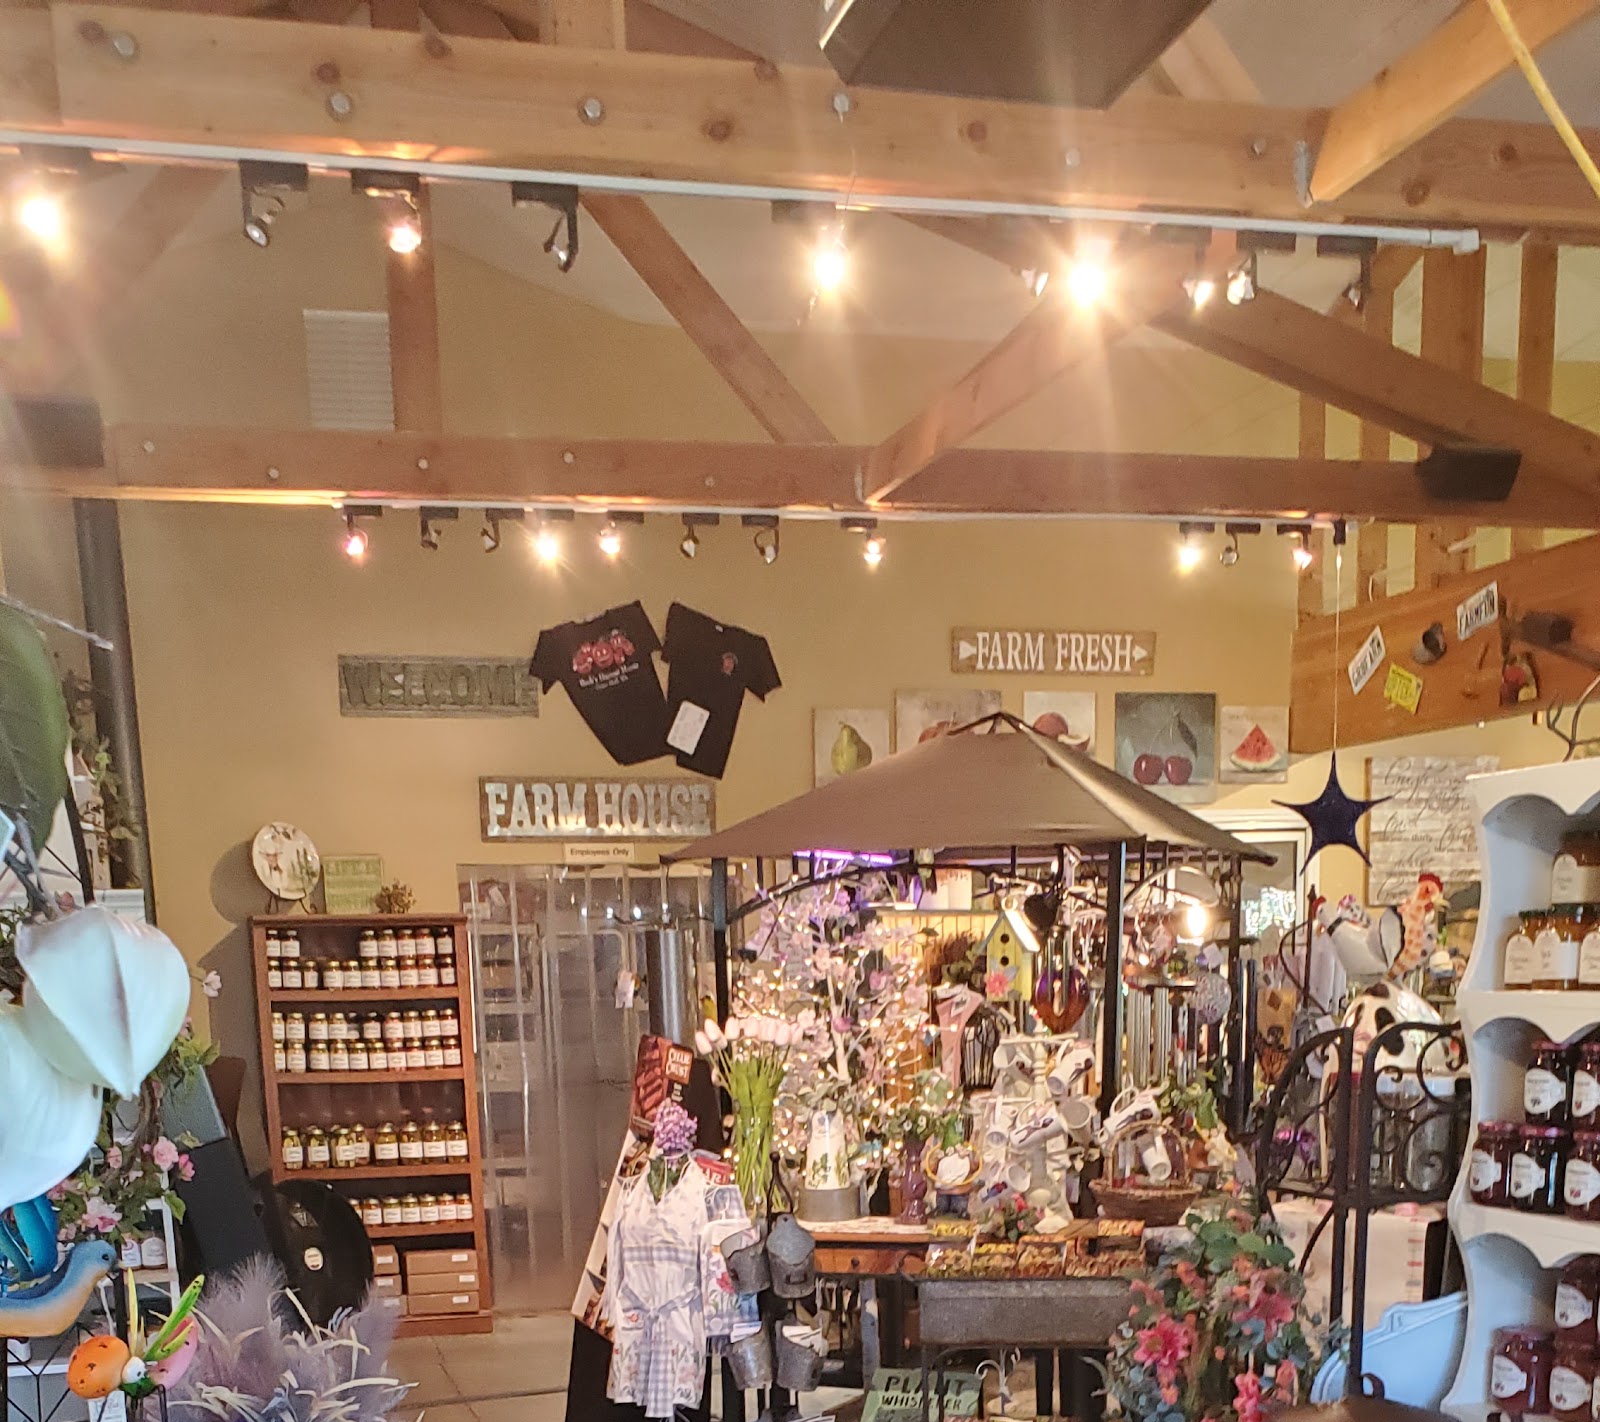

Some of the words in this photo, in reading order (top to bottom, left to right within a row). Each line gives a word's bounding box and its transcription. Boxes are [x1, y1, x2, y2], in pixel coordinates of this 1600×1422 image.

[976, 631, 1045, 671] FARM
[1055, 633, 1133, 672] FRESH
[342, 661, 535, 706] WELCOME
[485, 782, 587, 836] FARM
[595, 782, 711, 836] HOUSE
[570, 848, 610, 857] Employees
[612, 847, 629, 858] Only
[881, 1394, 961, 1411] WHISEER
